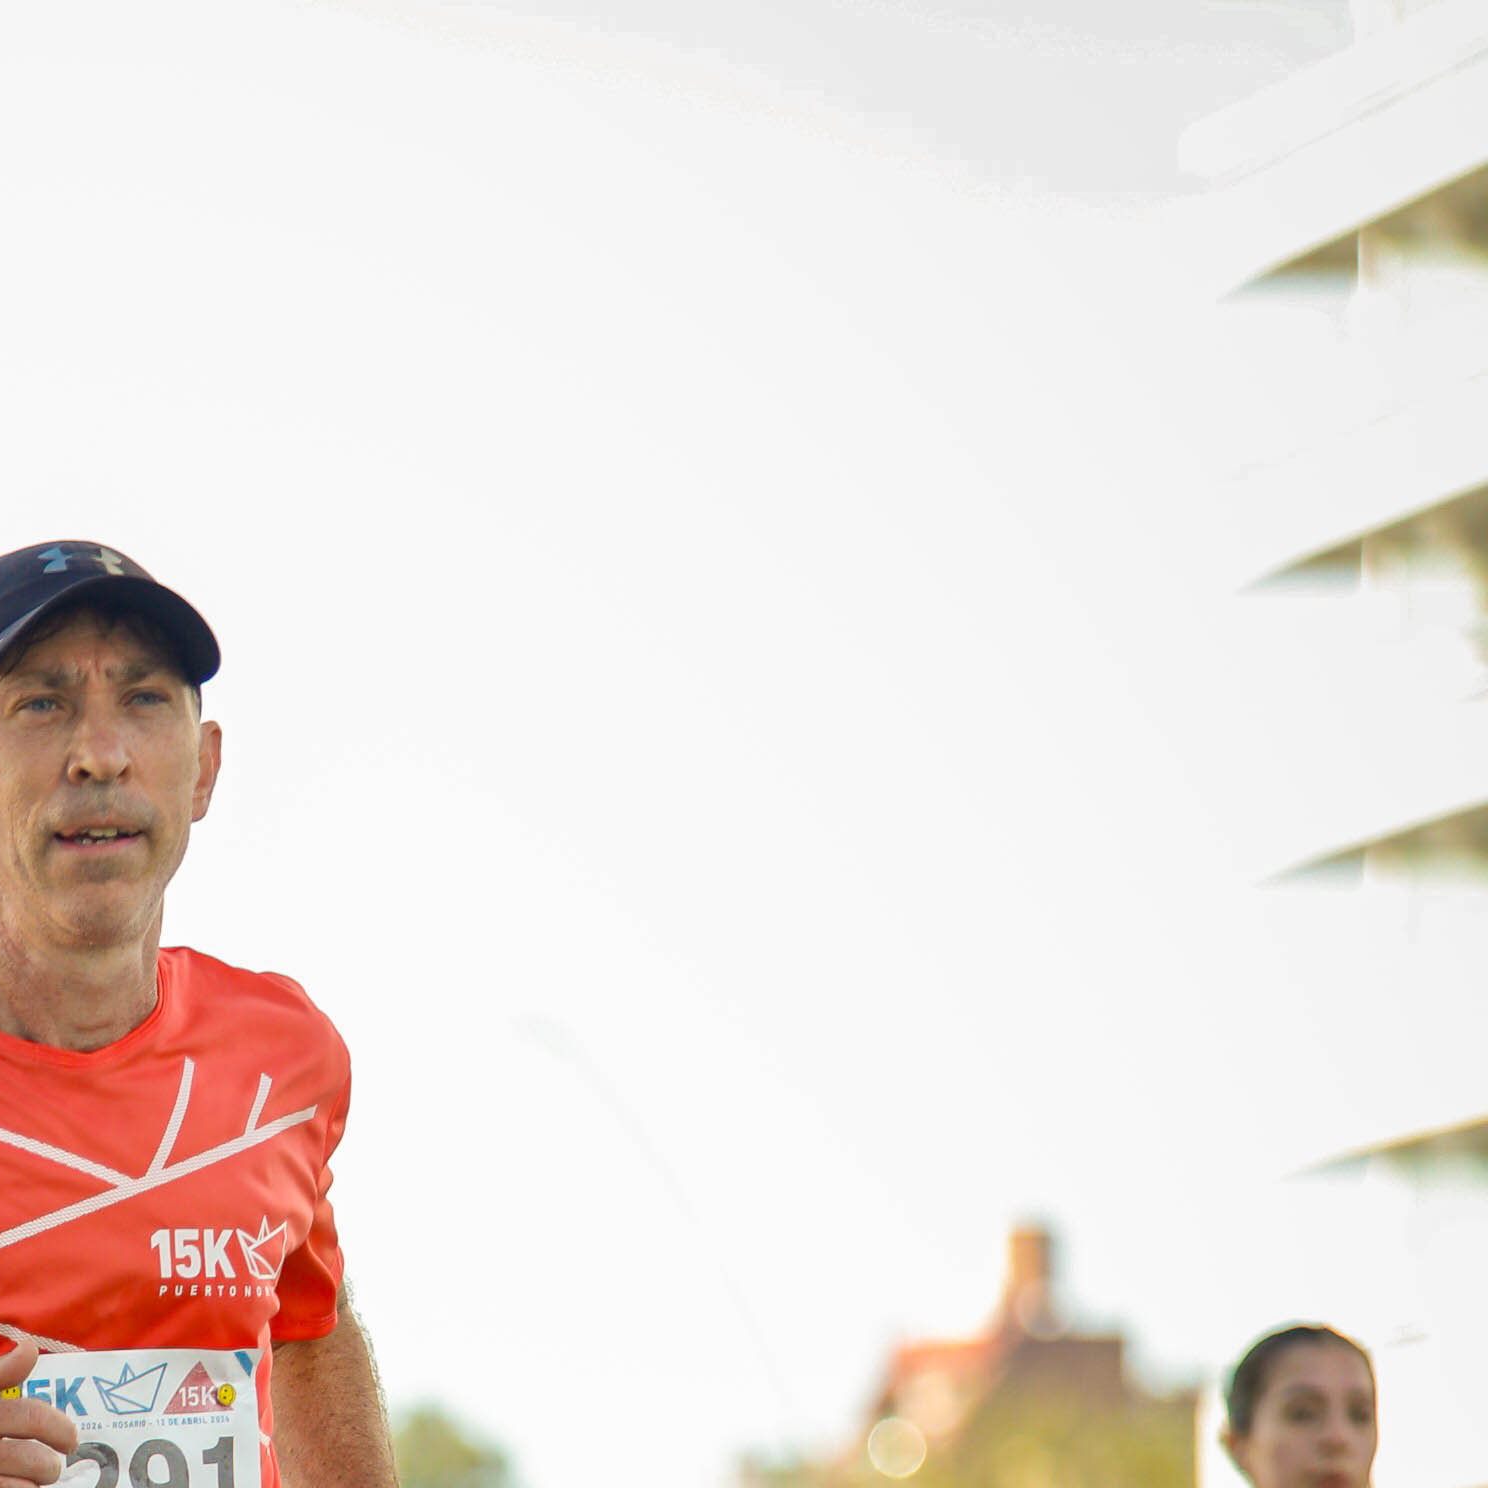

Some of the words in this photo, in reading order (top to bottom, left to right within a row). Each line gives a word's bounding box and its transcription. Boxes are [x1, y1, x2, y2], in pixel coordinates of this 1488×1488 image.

[150, 1228, 235, 1279] 15K
[158, 1284, 237, 1297] PUERTO
[20, 1375, 89, 1416] 5K
[178, 1385, 217, 1407] 15K
